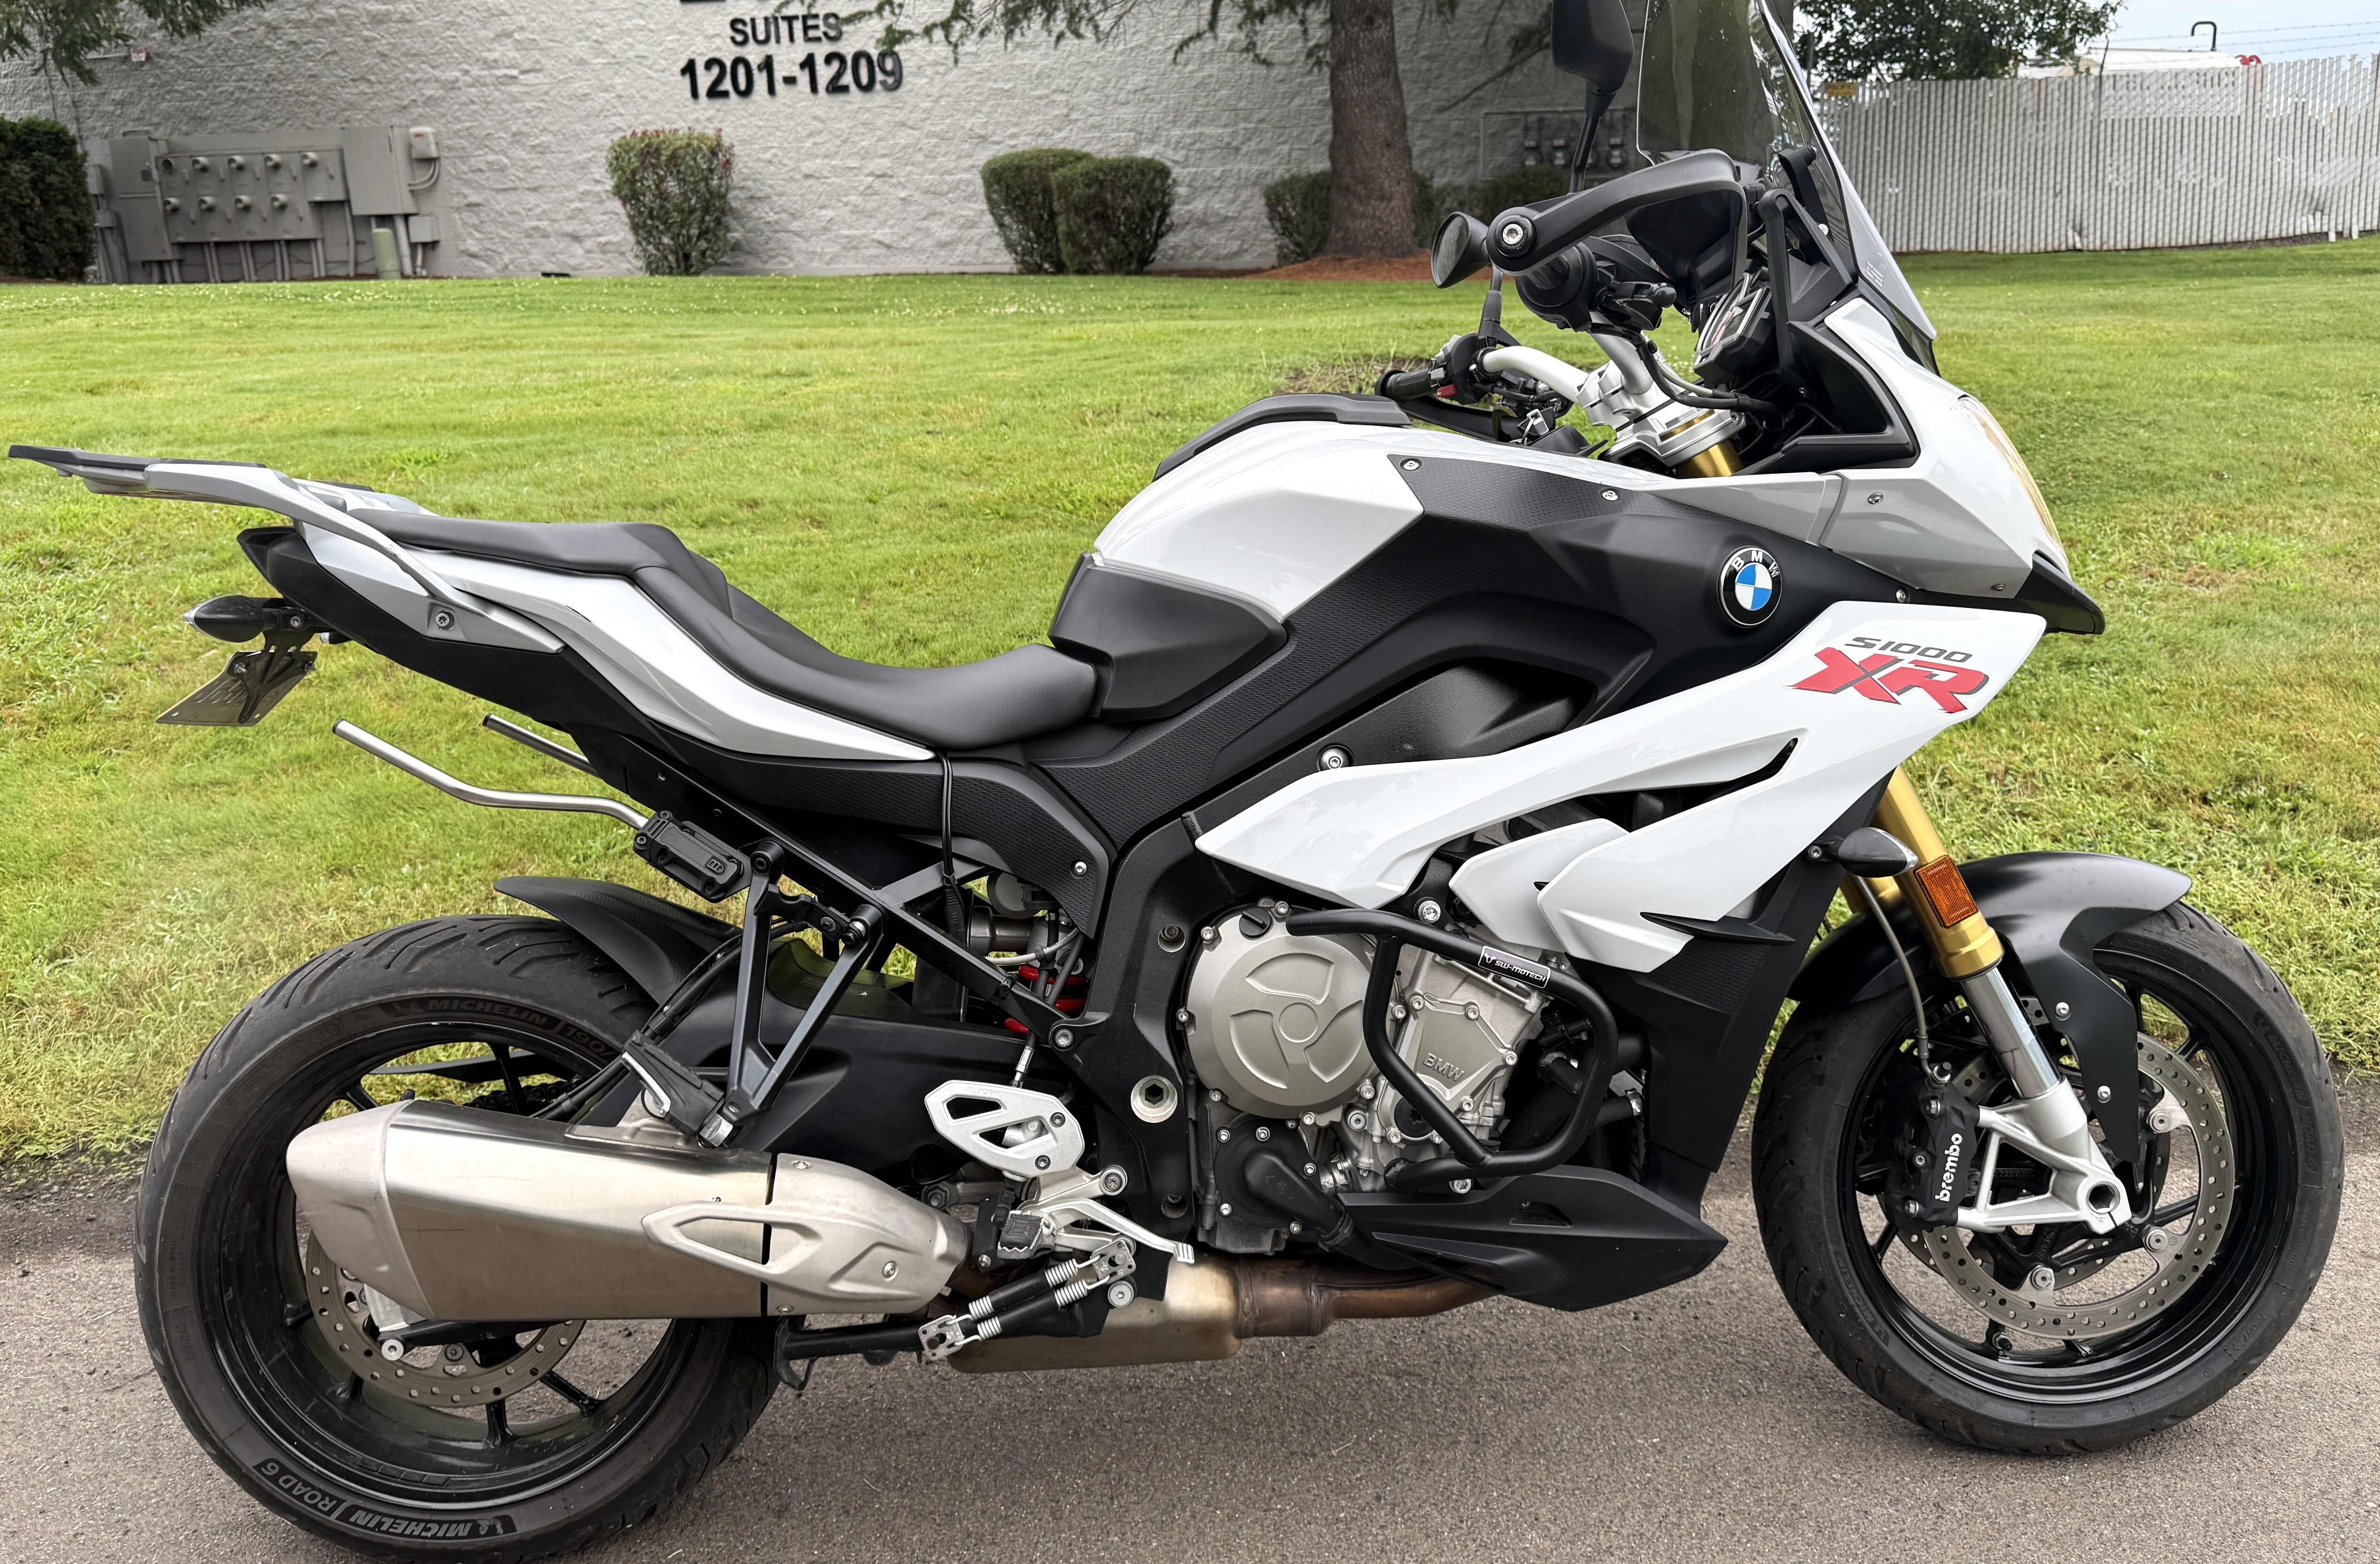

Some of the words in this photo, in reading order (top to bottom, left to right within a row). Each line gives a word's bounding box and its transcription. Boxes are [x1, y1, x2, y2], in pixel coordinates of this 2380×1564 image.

[730, 13, 843, 46] SUITES
[680, 49, 903, 99] 1201-1209
[1731, 549, 1780, 578] BMW
[1844, 636, 1973, 663] S1000
[1784, 647, 1990, 714] XR
[1494, 960, 1546, 982] SW-MOTECH
[428, 999, 549, 1025] MICHELIN
[1423, 1053, 1464, 1081] BMW
[1935, 1133, 1963, 1202] brembo
[260, 1462, 280, 1475] 6
[278, 1474, 337, 1511] ROAD
[349, 1509, 473, 1537] MICHELIN
